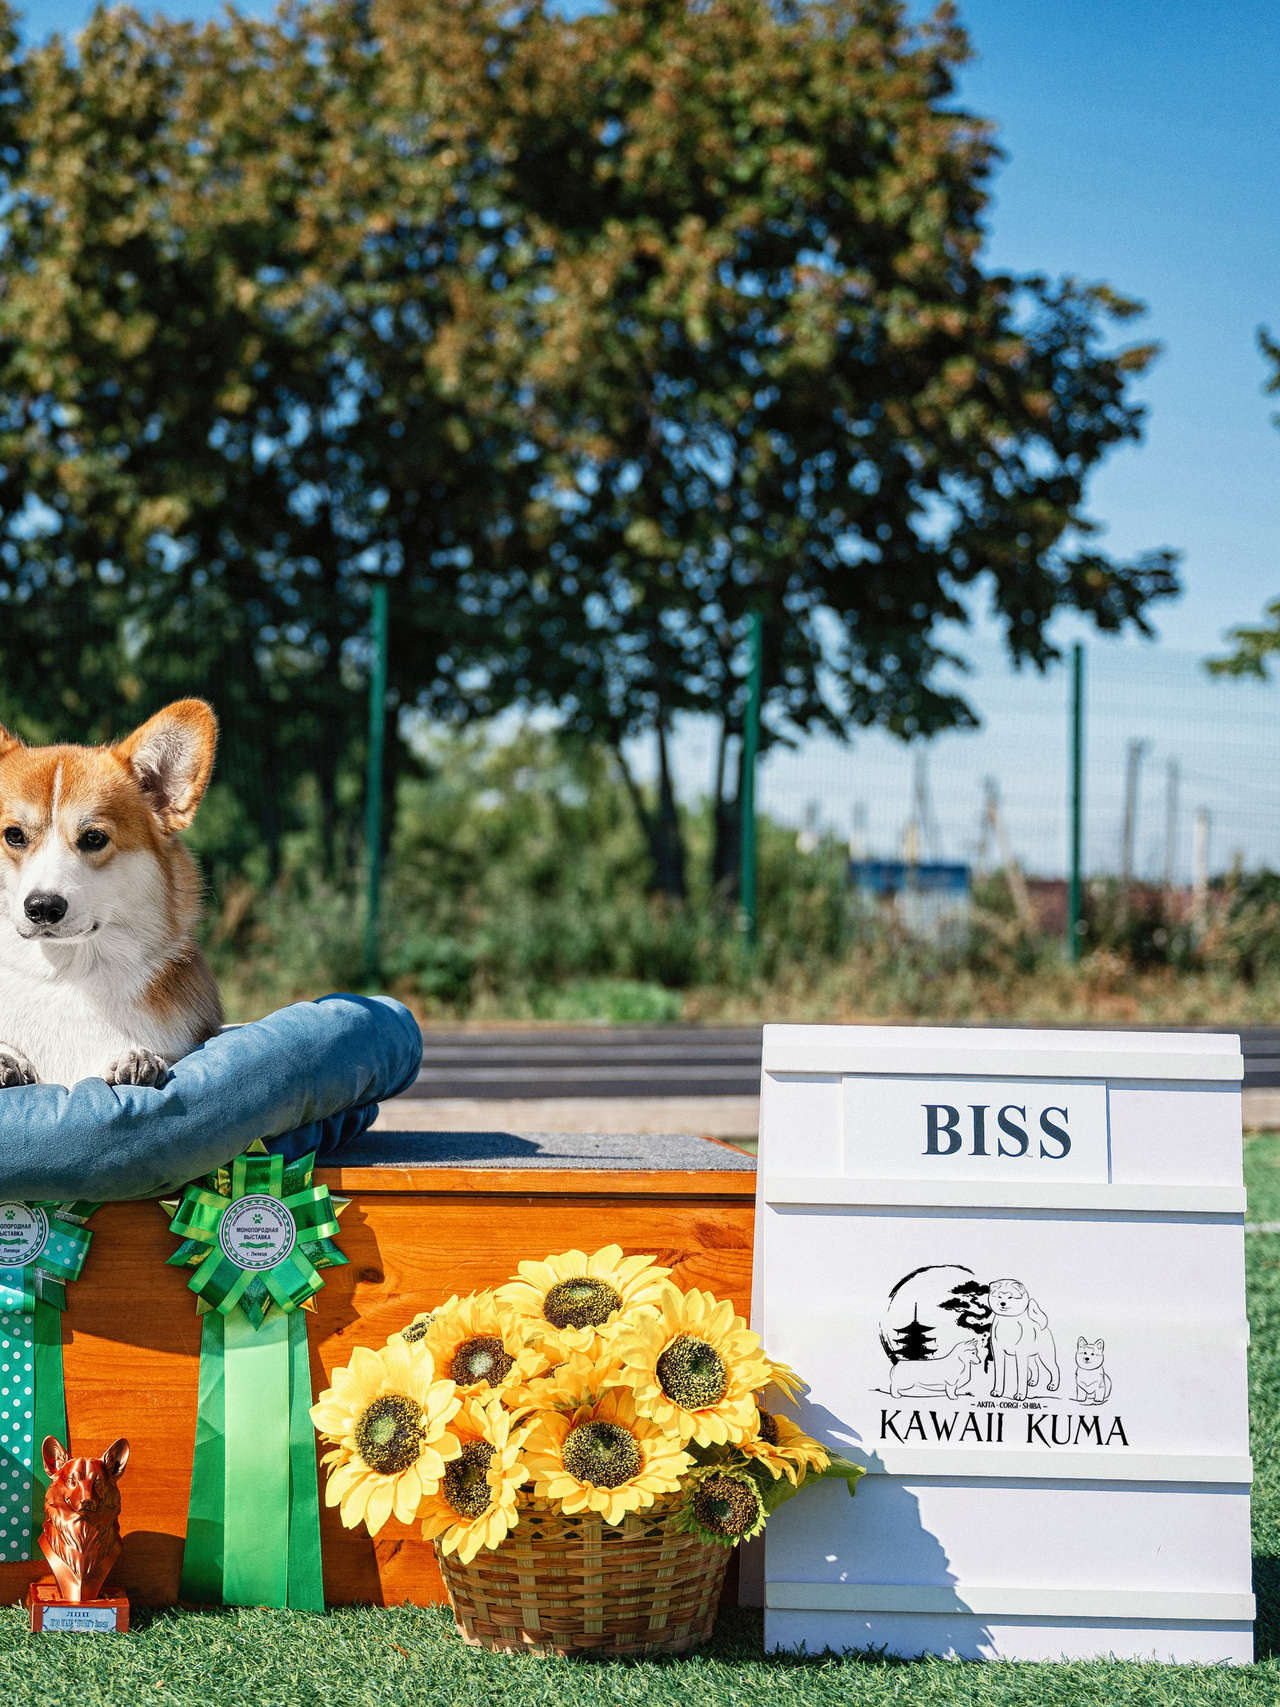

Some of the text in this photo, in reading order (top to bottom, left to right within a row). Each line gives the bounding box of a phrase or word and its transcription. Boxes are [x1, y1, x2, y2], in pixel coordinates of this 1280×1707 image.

[920, 1104, 1072, 1160] BISS
[999, 1401, 1019, 1409] CORGI
[1022, 1402, 1042, 1410] SHIBA
[879, 1409, 1130, 1449] KAWAII KUMA
